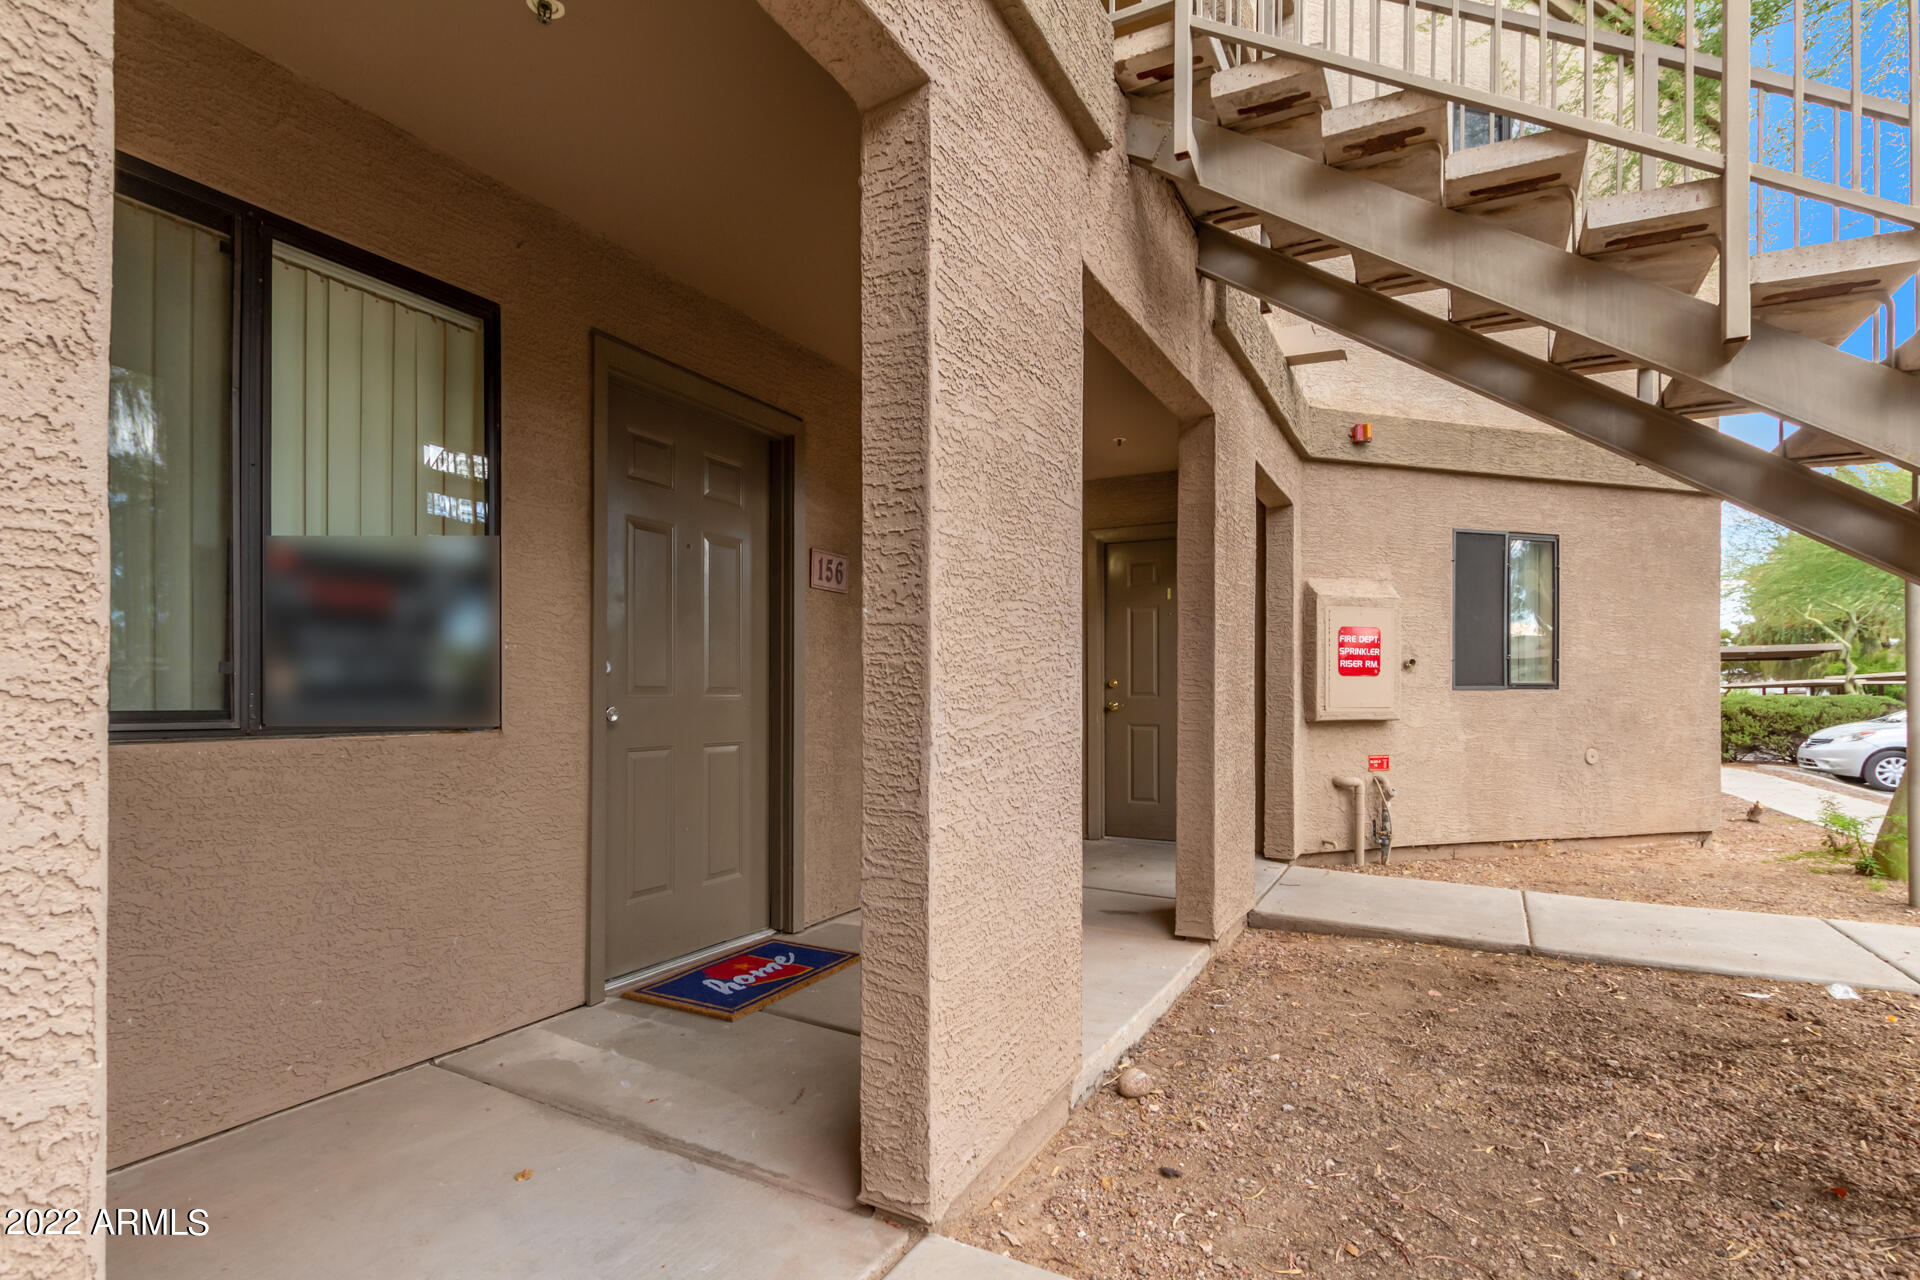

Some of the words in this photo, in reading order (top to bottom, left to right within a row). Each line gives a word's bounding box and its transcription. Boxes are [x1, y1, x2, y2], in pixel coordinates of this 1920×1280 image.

[818, 557, 844, 585] 156
[1339, 634, 1357, 643] FIRE
[1339, 647, 1380, 656] SPRINKLER
[1340, 659, 1363, 668] RISER
[702, 952, 795, 995] home
